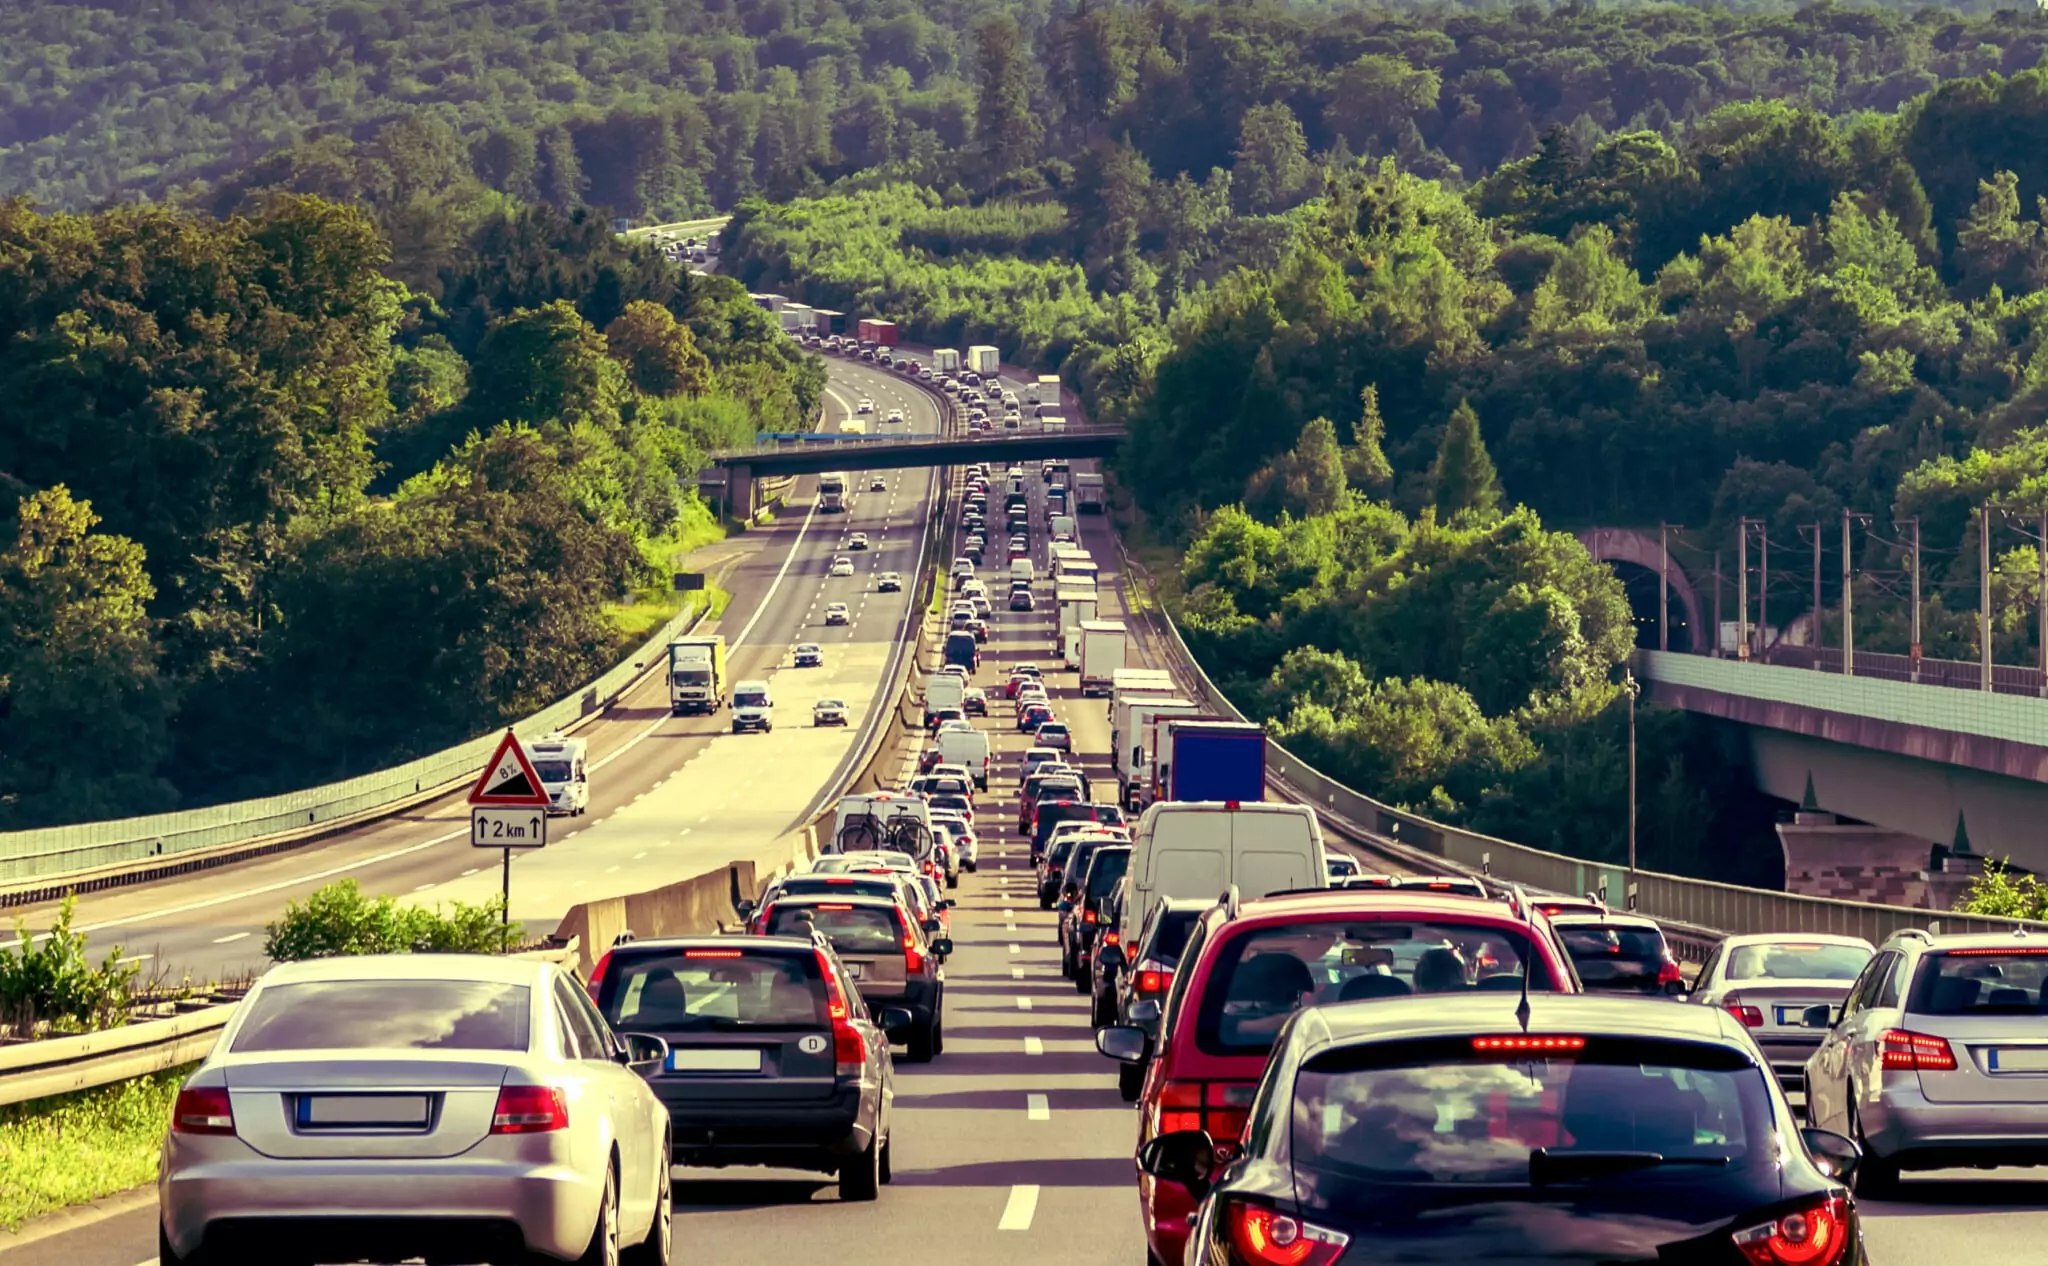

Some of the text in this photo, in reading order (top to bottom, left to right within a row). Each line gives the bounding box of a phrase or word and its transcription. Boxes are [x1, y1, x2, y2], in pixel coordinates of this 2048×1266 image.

[499, 762, 517, 779] 8%
[493, 820, 525, 838] 2 km
[809, 1038, 817, 1049] D
